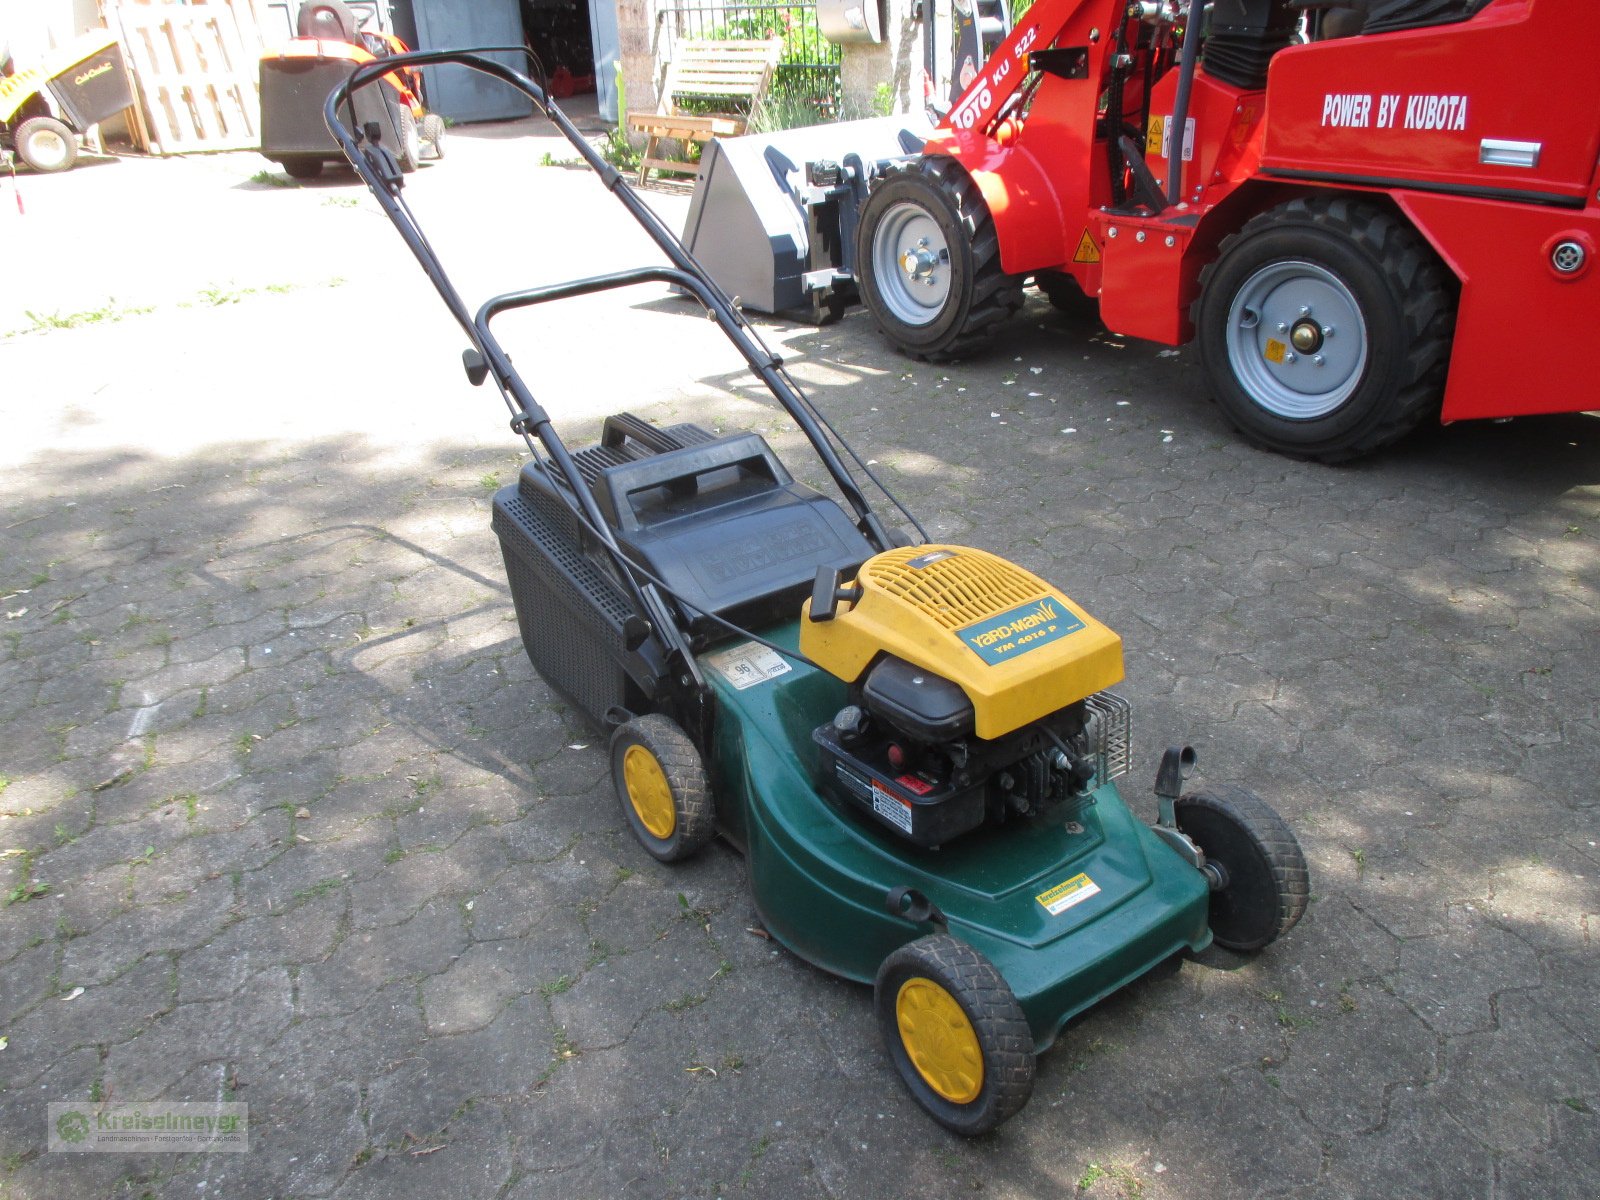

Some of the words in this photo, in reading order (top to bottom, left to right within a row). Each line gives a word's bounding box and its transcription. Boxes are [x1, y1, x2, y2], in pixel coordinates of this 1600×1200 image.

[949, 76, 992, 129] TOYO
[992, 58, 1010, 87] KU
[1014, 27, 1037, 59] 522
[1321, 94, 1372, 128] POWER
[1376, 94, 1400, 129] BY
[1404, 95, 1468, 131] KUBOTA
[994, 642, 1015, 654] YM
[1048, 625, 1057, 633] P
